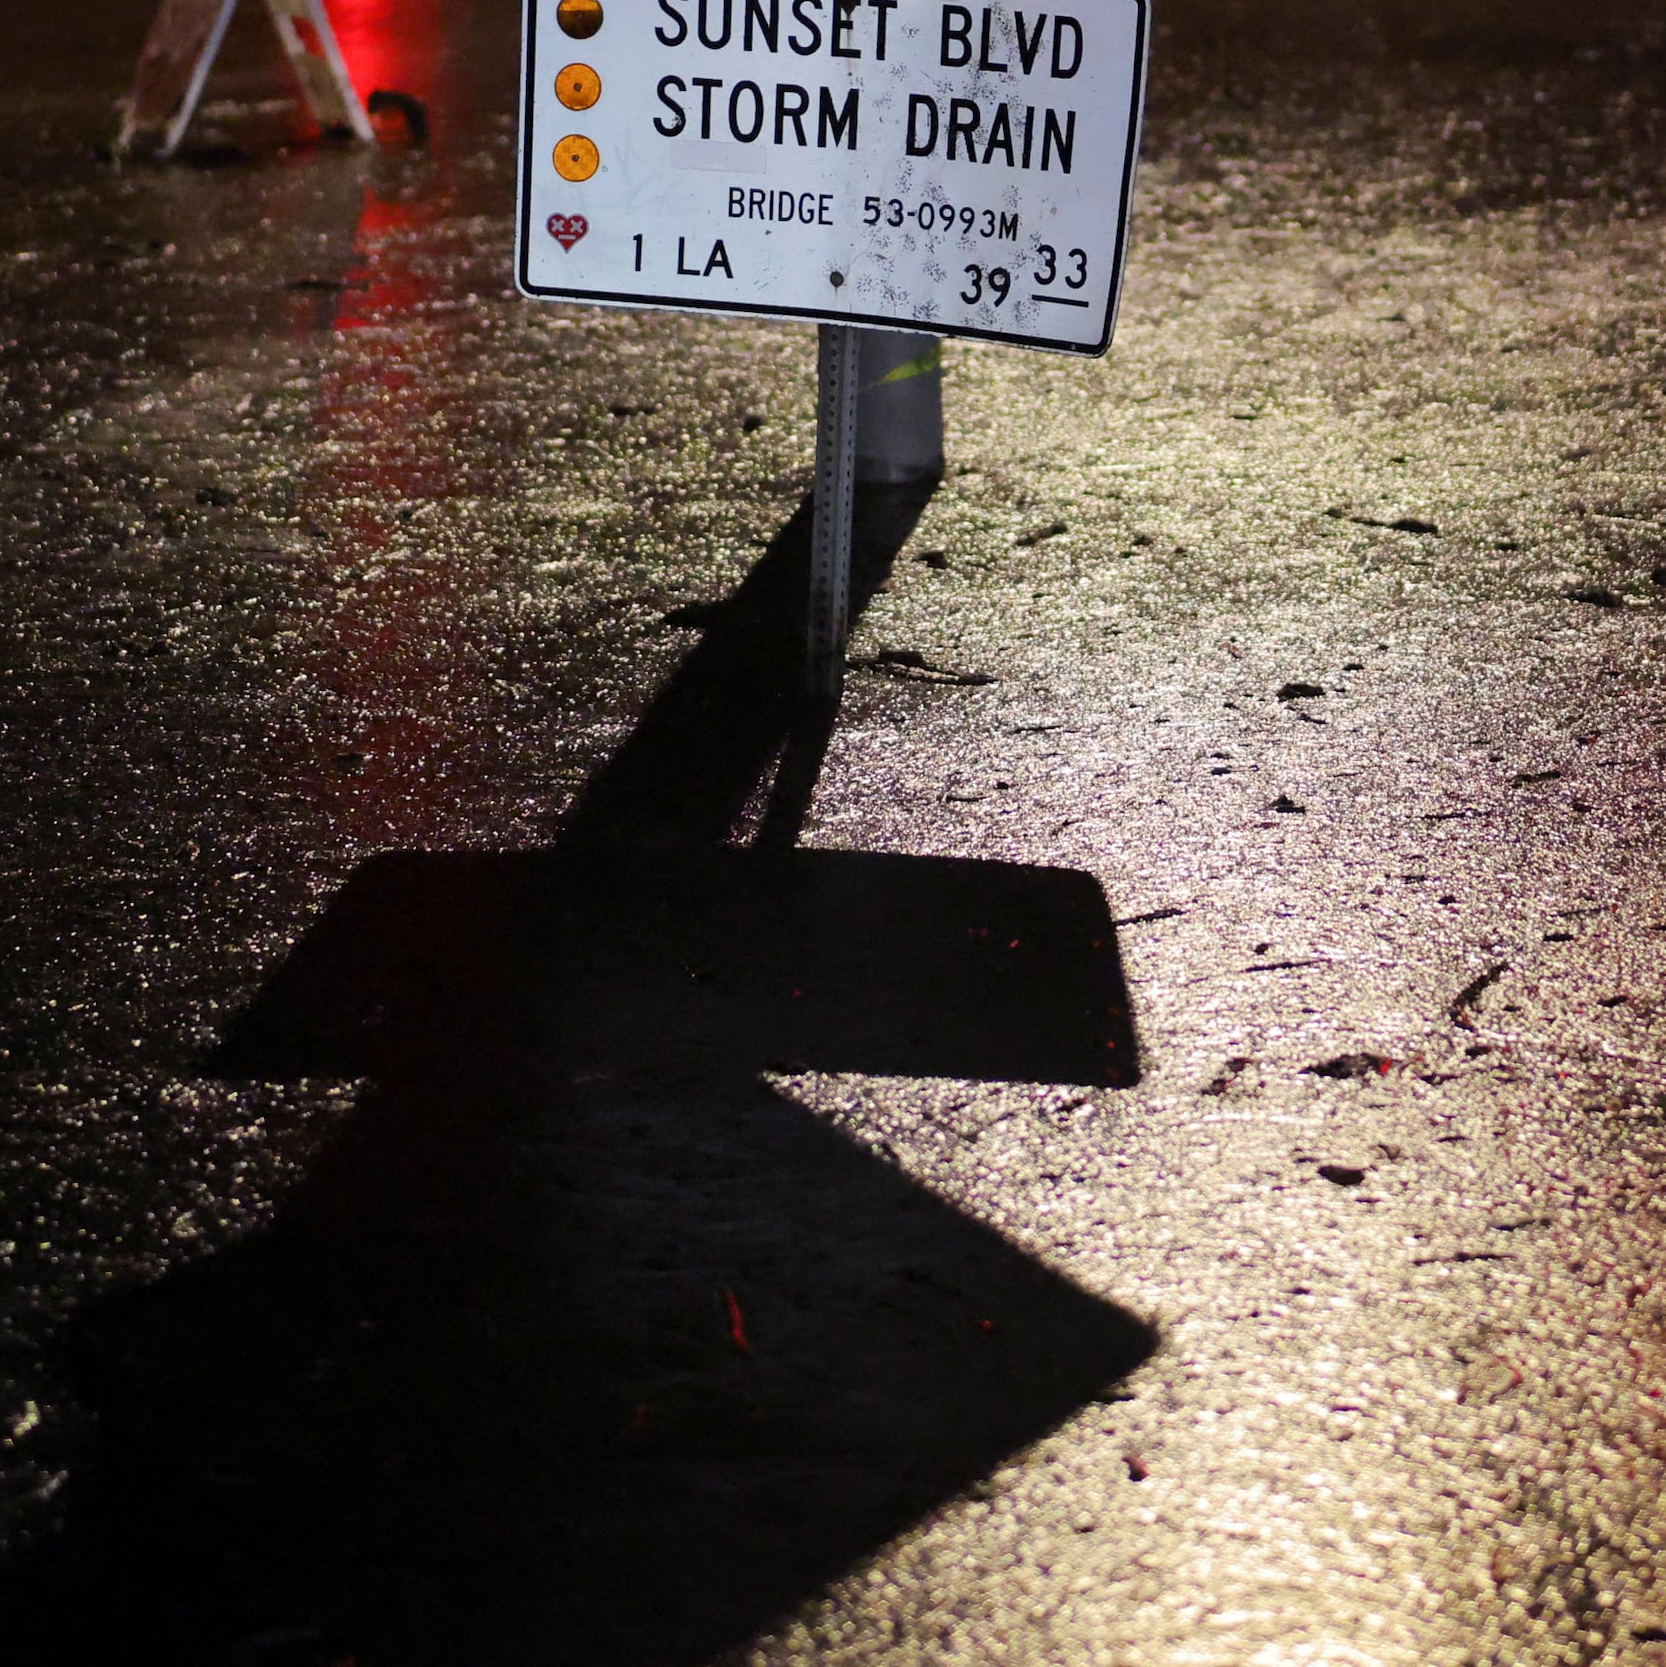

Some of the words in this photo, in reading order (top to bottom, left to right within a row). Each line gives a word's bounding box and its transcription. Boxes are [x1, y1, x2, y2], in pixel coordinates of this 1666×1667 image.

[939, 3, 1084, 80] BLVD
[652, 74, 861, 151] STORM
[906, 93, 1077, 175] DRAIN
[727, 186, 834, 227] BRIDGE
[862, 195, 1019, 242] 53-0993M
[632, 233, 643, 273] 1
[677, 238, 734, 280] LA
[960, 263, 1012, 308] 39
[1032, 244, 1088, 289] 33
